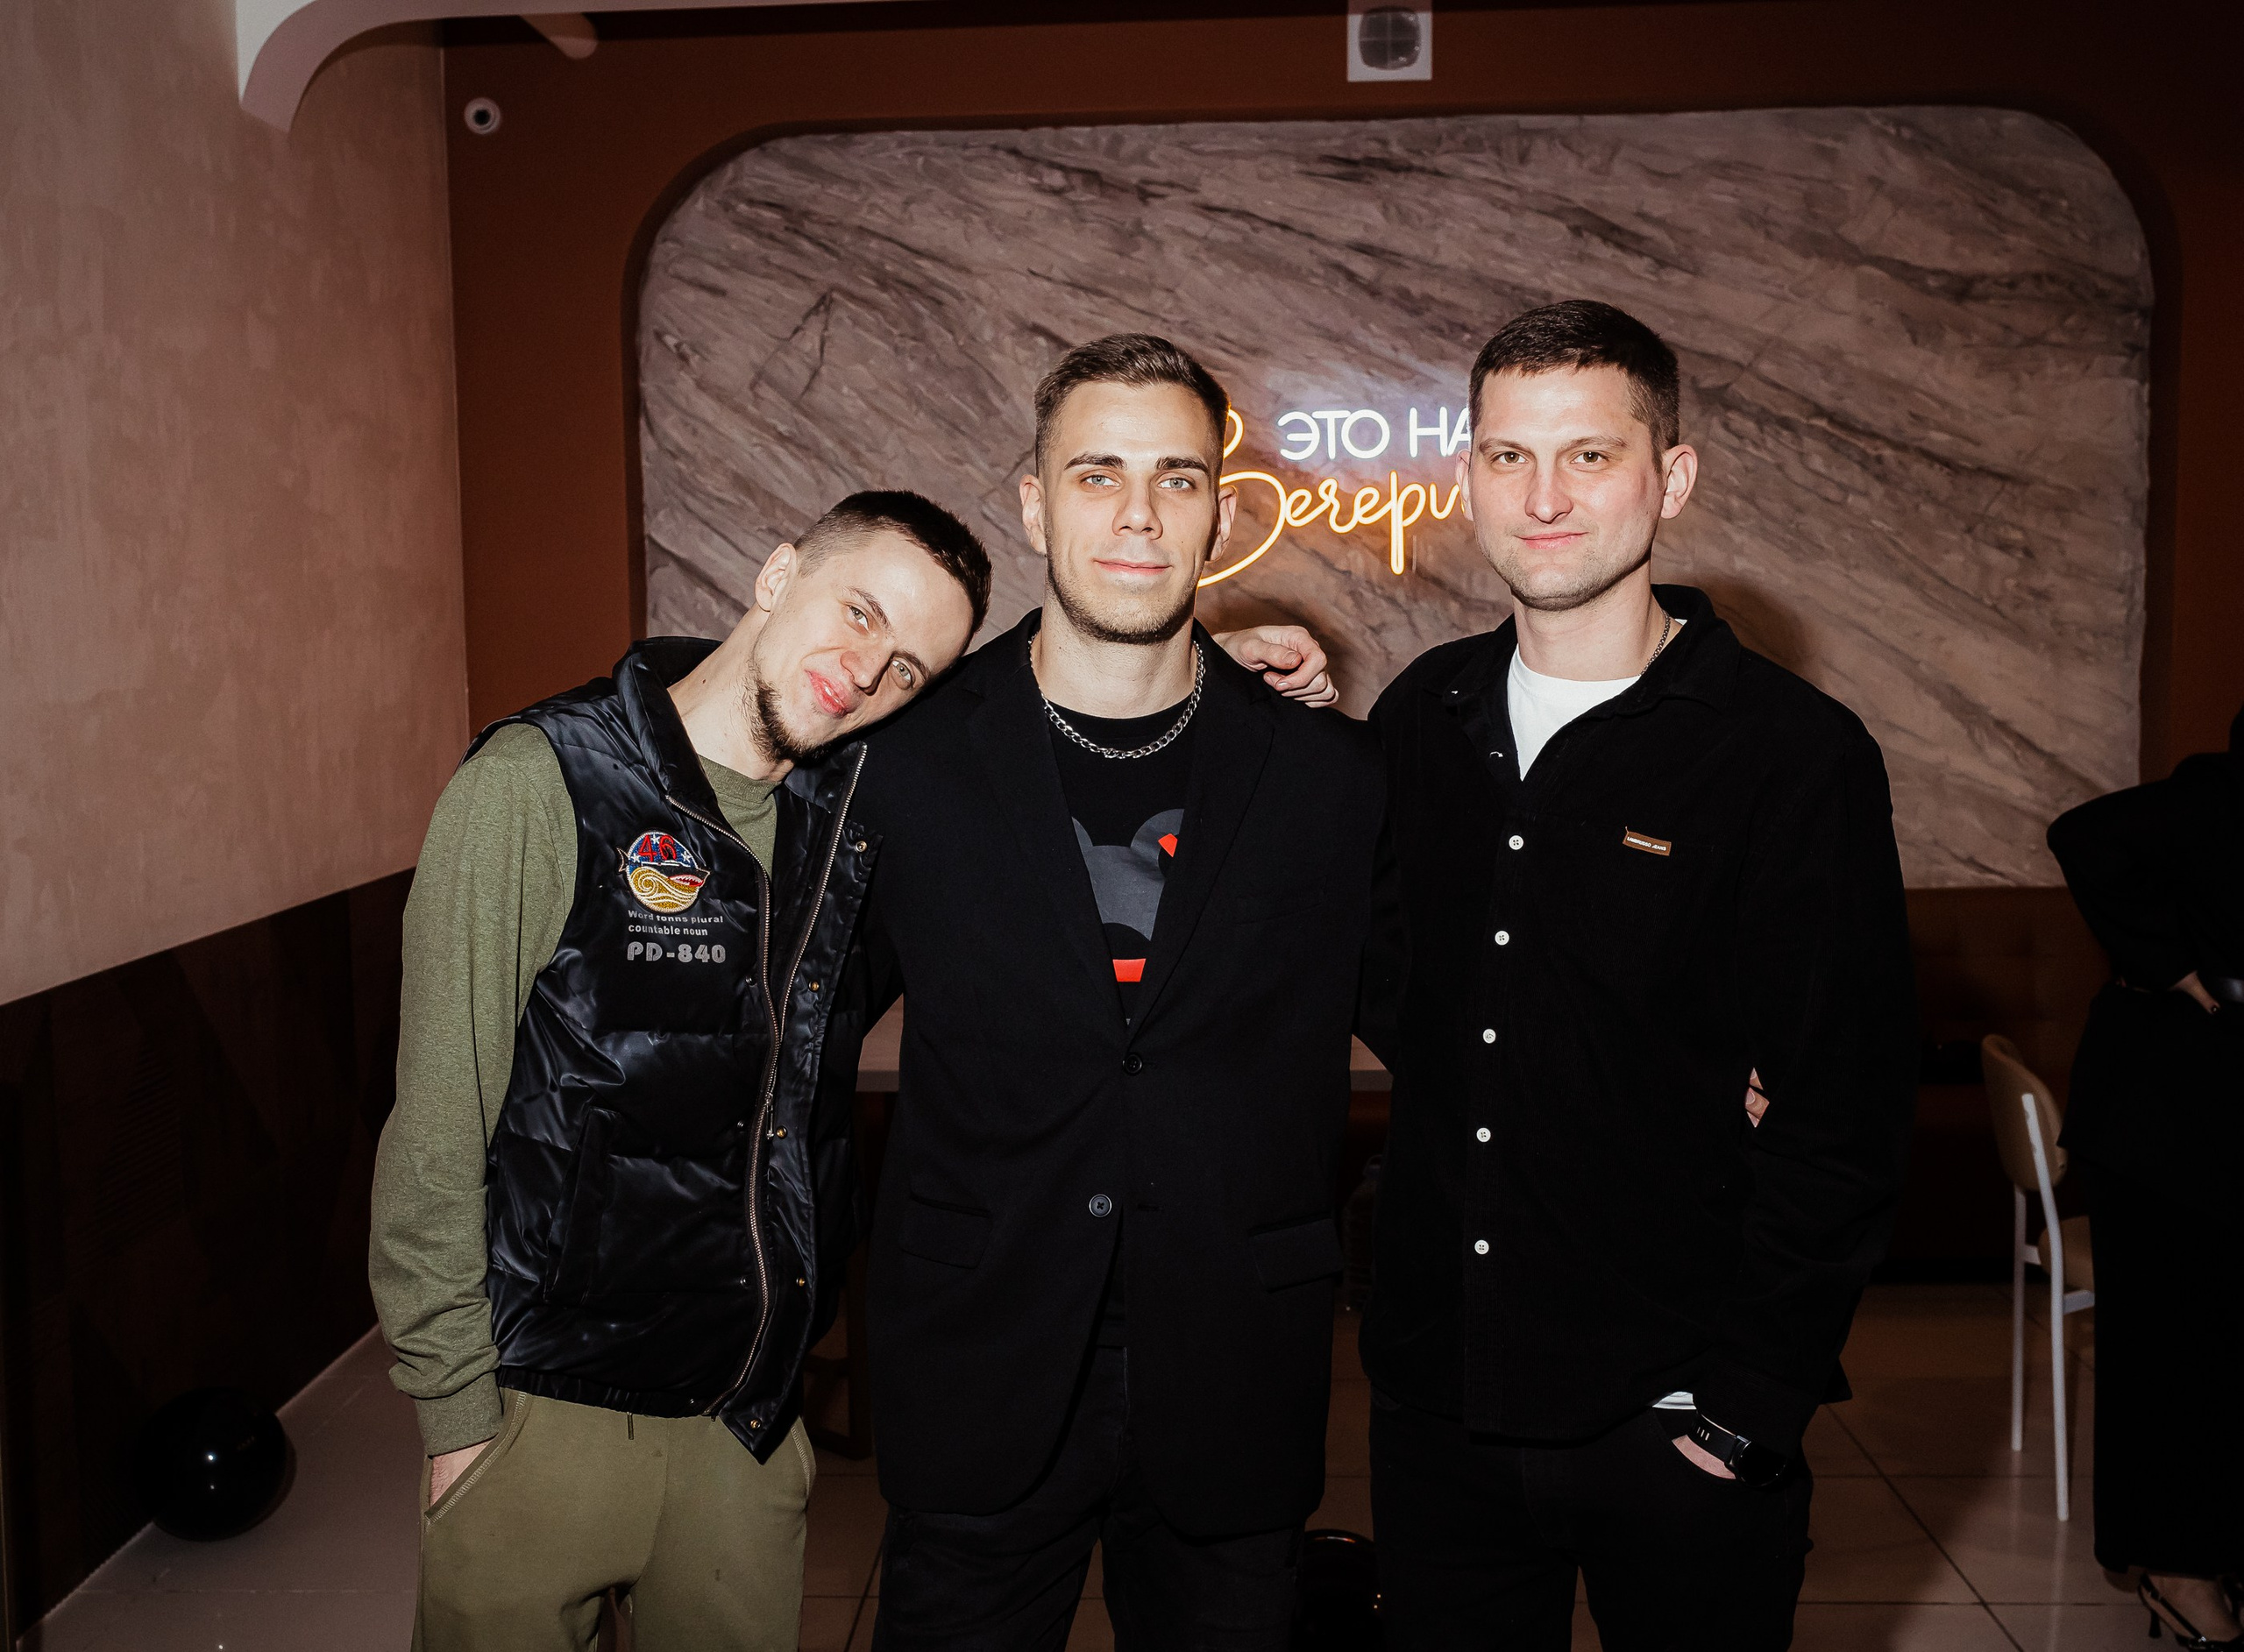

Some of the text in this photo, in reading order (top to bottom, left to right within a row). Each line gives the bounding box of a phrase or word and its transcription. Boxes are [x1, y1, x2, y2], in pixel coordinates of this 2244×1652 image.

[1277, 408, 1391, 461] ЭТО
[638, 834, 677, 861] 46
[628, 910, 654, 920] Word
[628, 925, 708, 936] countable noun
[627, 940, 726, 963] PD-840
